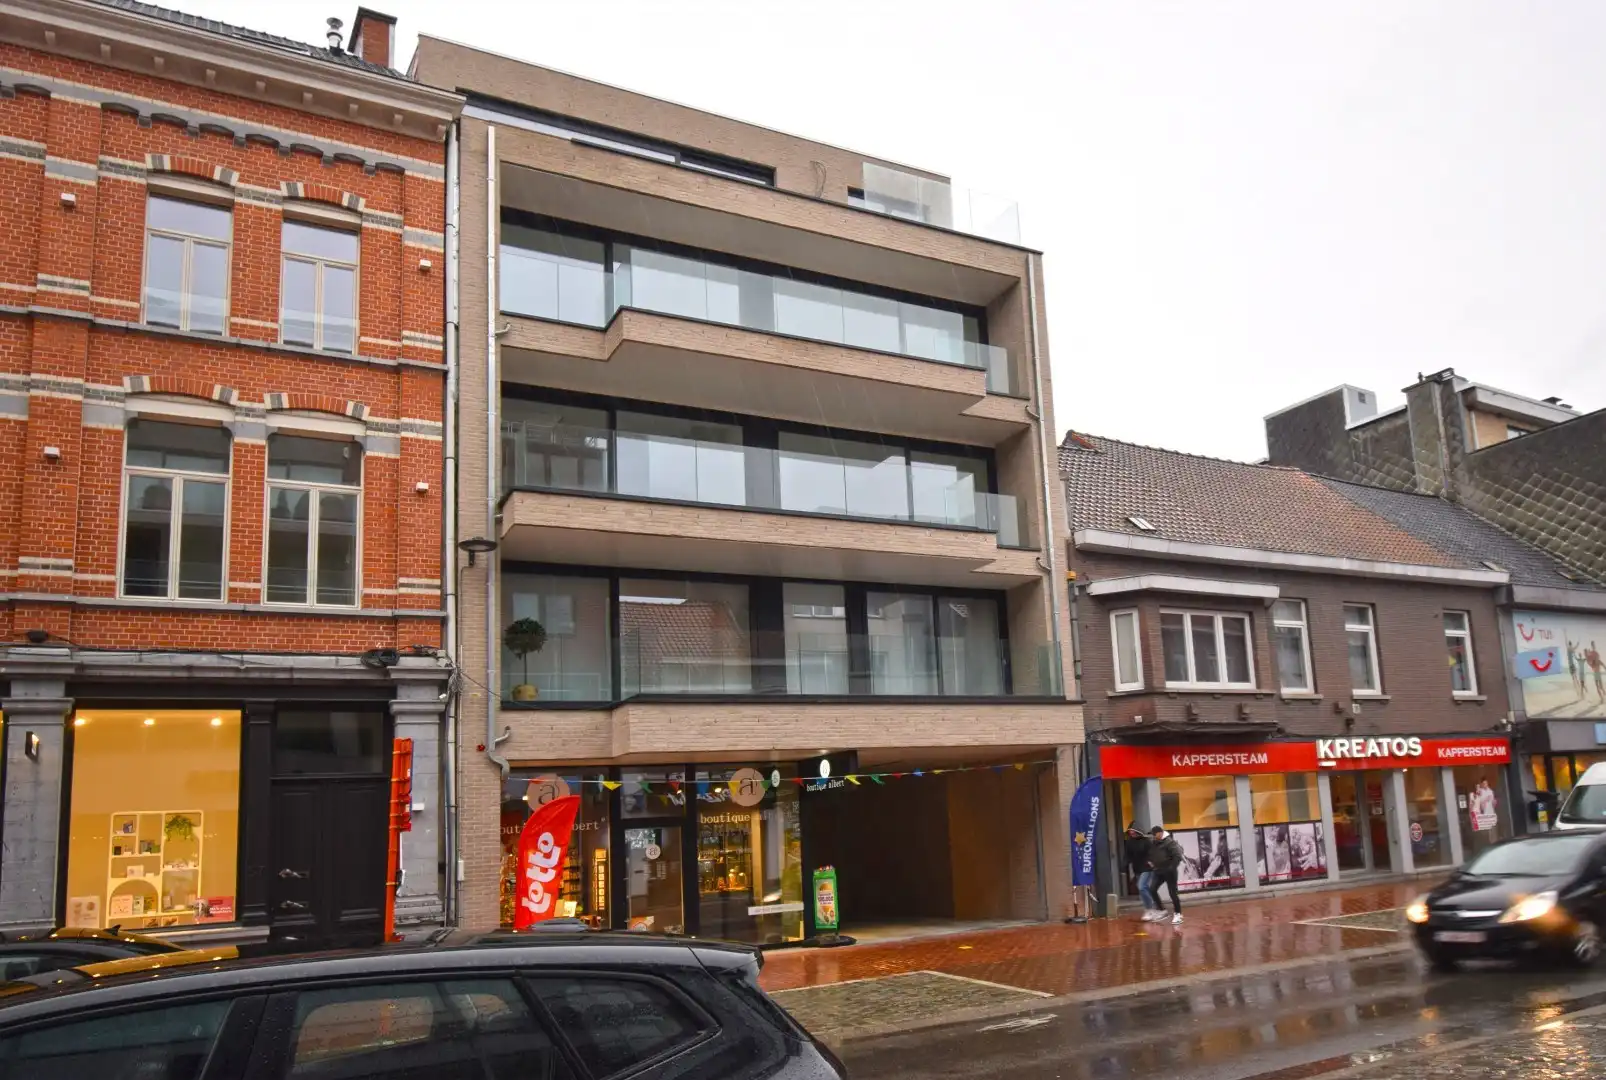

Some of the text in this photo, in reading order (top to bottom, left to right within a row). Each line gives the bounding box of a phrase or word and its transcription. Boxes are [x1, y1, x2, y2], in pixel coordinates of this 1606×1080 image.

[1316, 736, 1423, 759] KREATOS
[1437, 745, 1507, 758] KAPPERSTEAM
[1171, 752, 1268, 767] KAPPERSTEAM
[806, 779, 845, 793] boutique albert
[700, 812, 751, 824] boutique
[1082, 796, 1100, 873] EUROMILLIONS
